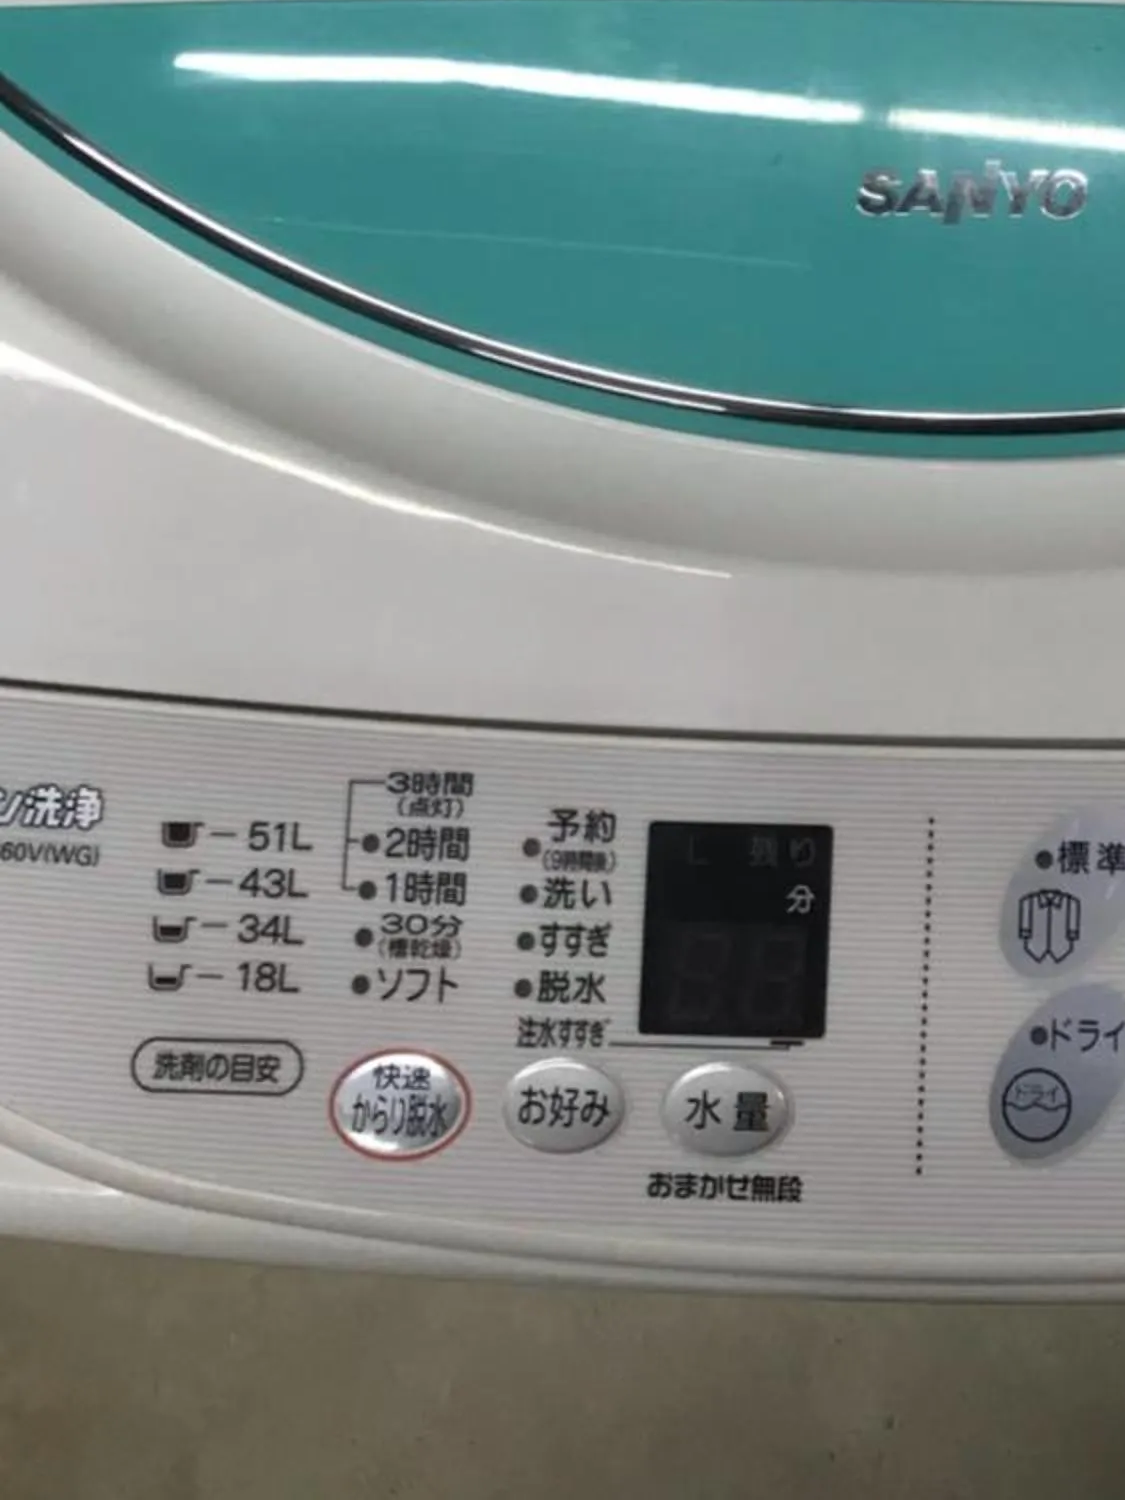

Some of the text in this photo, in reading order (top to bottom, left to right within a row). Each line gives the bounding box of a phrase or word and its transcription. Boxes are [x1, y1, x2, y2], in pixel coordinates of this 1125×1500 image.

[856, 160, 1088, 225] SANYO
[386, 771, 474, 797] 3時間
[248, 822, 313, 852] 51L
[546, 808, 617, 843] 予約
[385, 826, 470, 862] 2時間
[239, 869, 310, 899] 43L
[386, 871, 467, 907] 1時間
[543, 876, 612, 909] 洗い
[787, 884, 815, 914] 分
[237, 915, 305, 946] 34L
[381, 912, 463, 937] 30分
[539, 921, 612, 958] すすぎ
[238, 962, 301, 994] 18L
[379, 966, 458, 1002] ソフト
[537, 970, 606, 1004] 脱水
[516, 1016, 611, 1049] 注水すすぎ
[152, 1052, 282, 1085] 洗剤の目安
[373, 1064, 431, 1091] 快速
[352, 1095, 448, 1138] からり脱水
[517, 1086, 611, 1129] お好み
[685, 1089, 771, 1133] 水量
[646, 1172, 804, 1203] おまかせ無段
